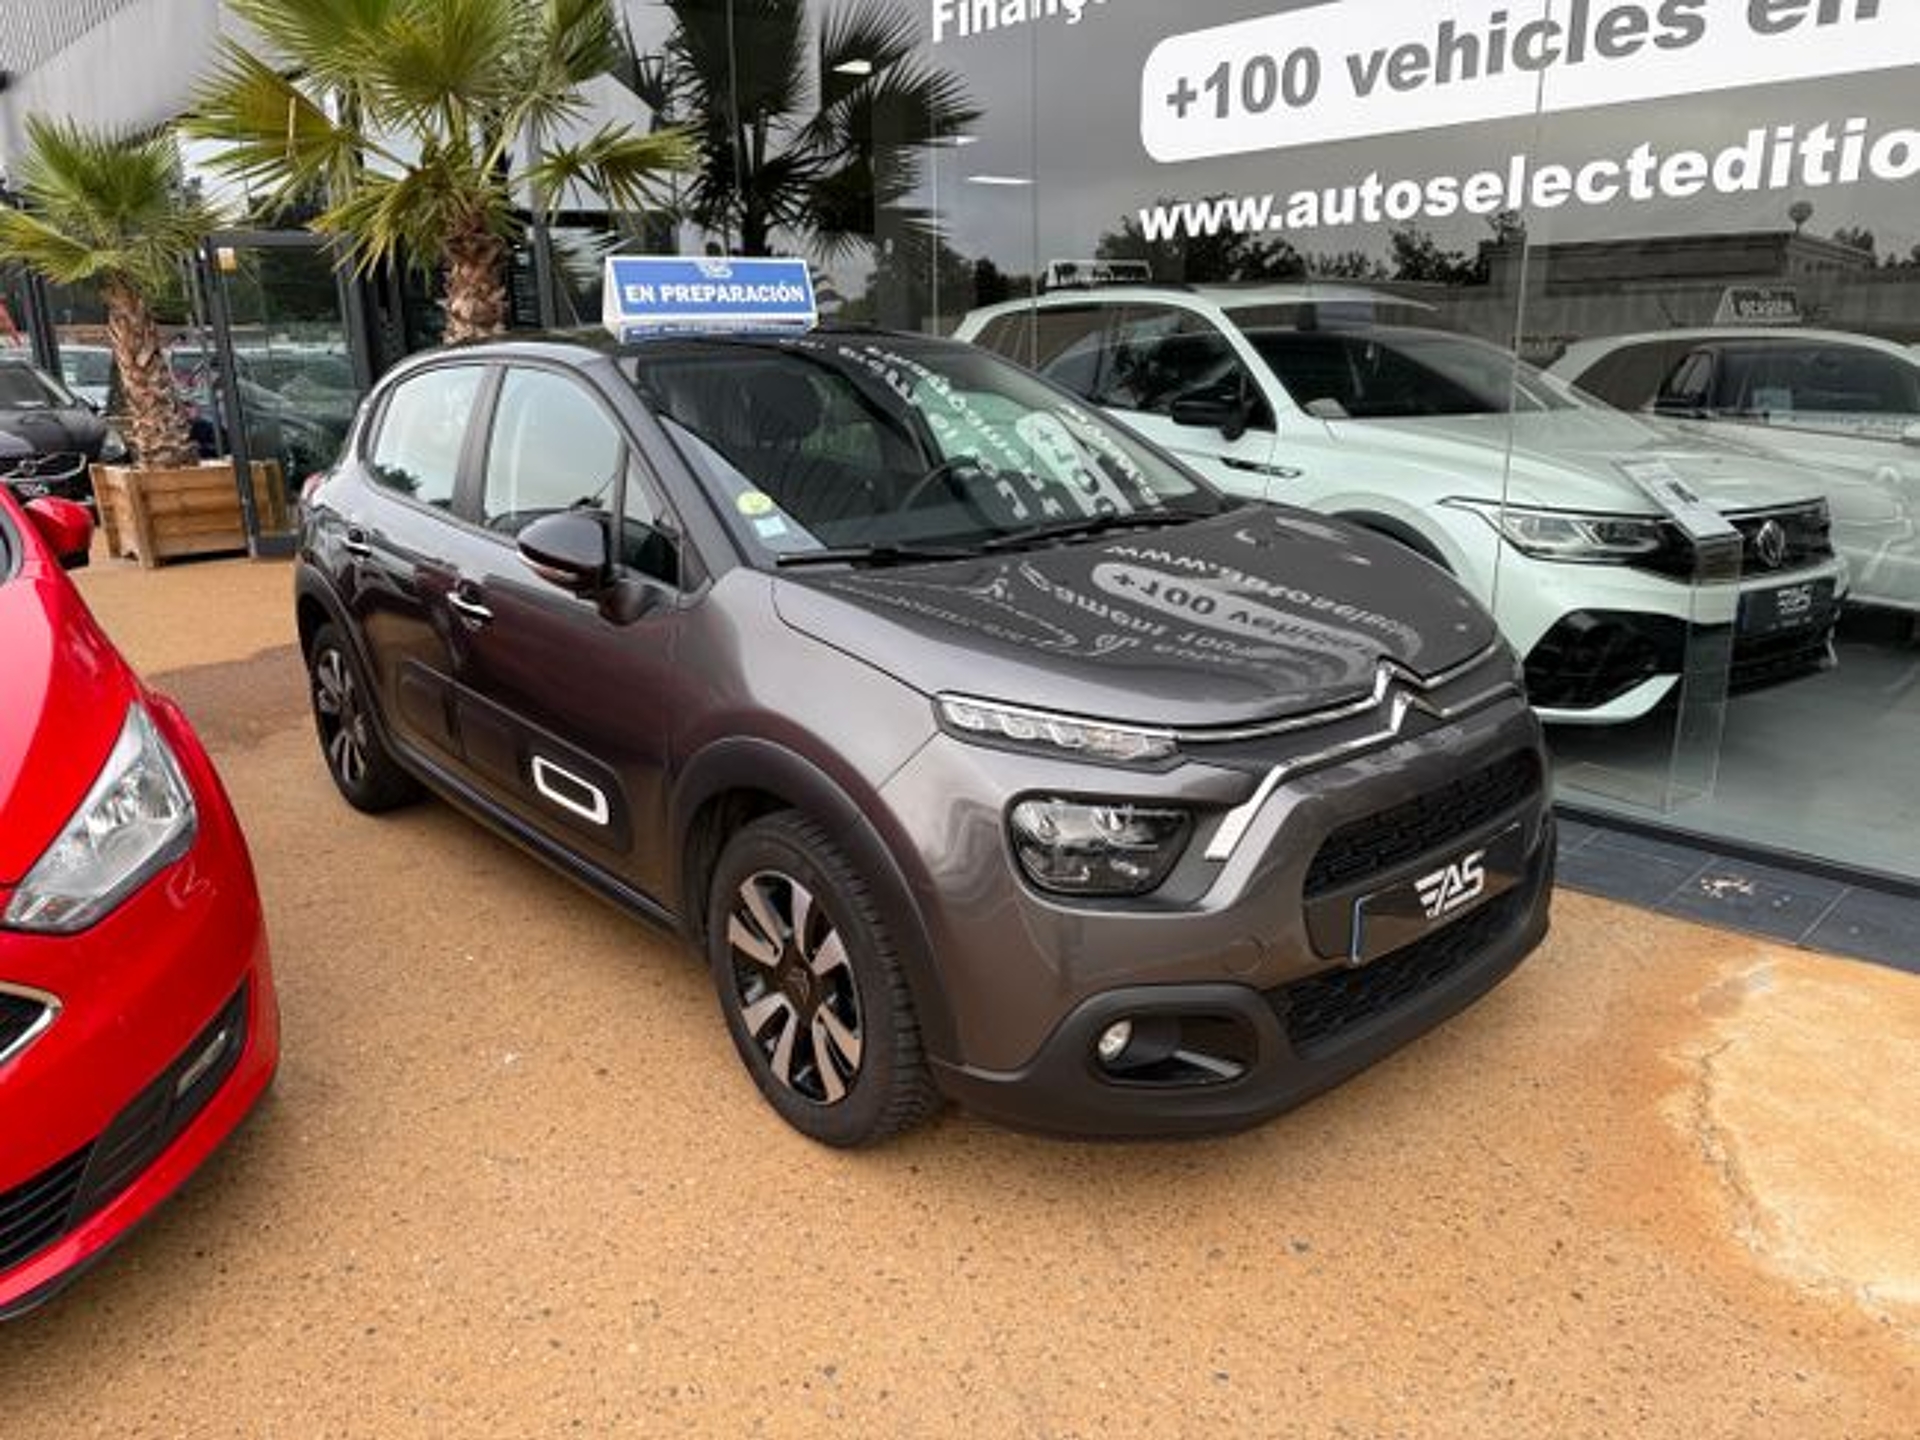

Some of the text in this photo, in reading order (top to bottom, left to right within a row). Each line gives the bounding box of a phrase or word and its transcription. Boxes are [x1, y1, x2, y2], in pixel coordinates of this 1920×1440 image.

[1166, 46, 1321, 120] +100
[1346, 0, 1707, 98] vehicles
[1138, 117, 1920, 242] www.autoselecteditio
[624, 279, 805, 304] EN PREPARACIÓN
